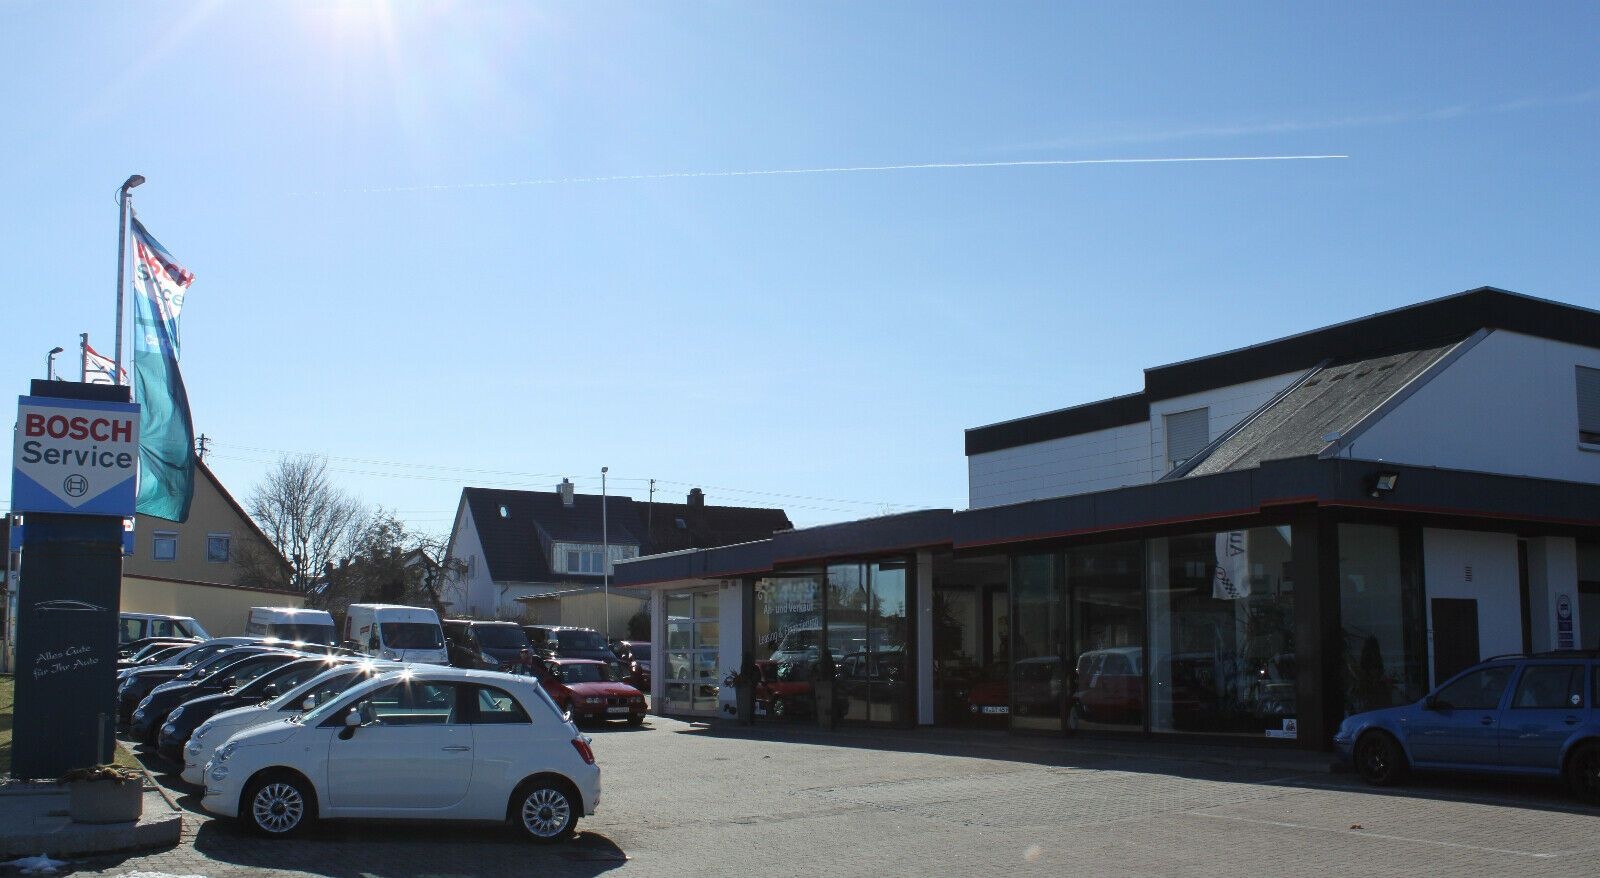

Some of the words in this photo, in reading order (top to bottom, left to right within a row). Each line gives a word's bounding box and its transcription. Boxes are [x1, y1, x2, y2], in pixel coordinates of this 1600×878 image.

[25, 414, 132, 443] BOSCH
[22, 441, 132, 468] Service
[775, 603, 788, 613] und
[789, 602, 814, 613] Verkauf
[37, 652, 63, 663] Alles
[66, 645, 92, 656] Gute
[33, 667, 49, 681] für
[51, 663, 70, 673] Ihr
[73, 657, 98, 669] Auto
